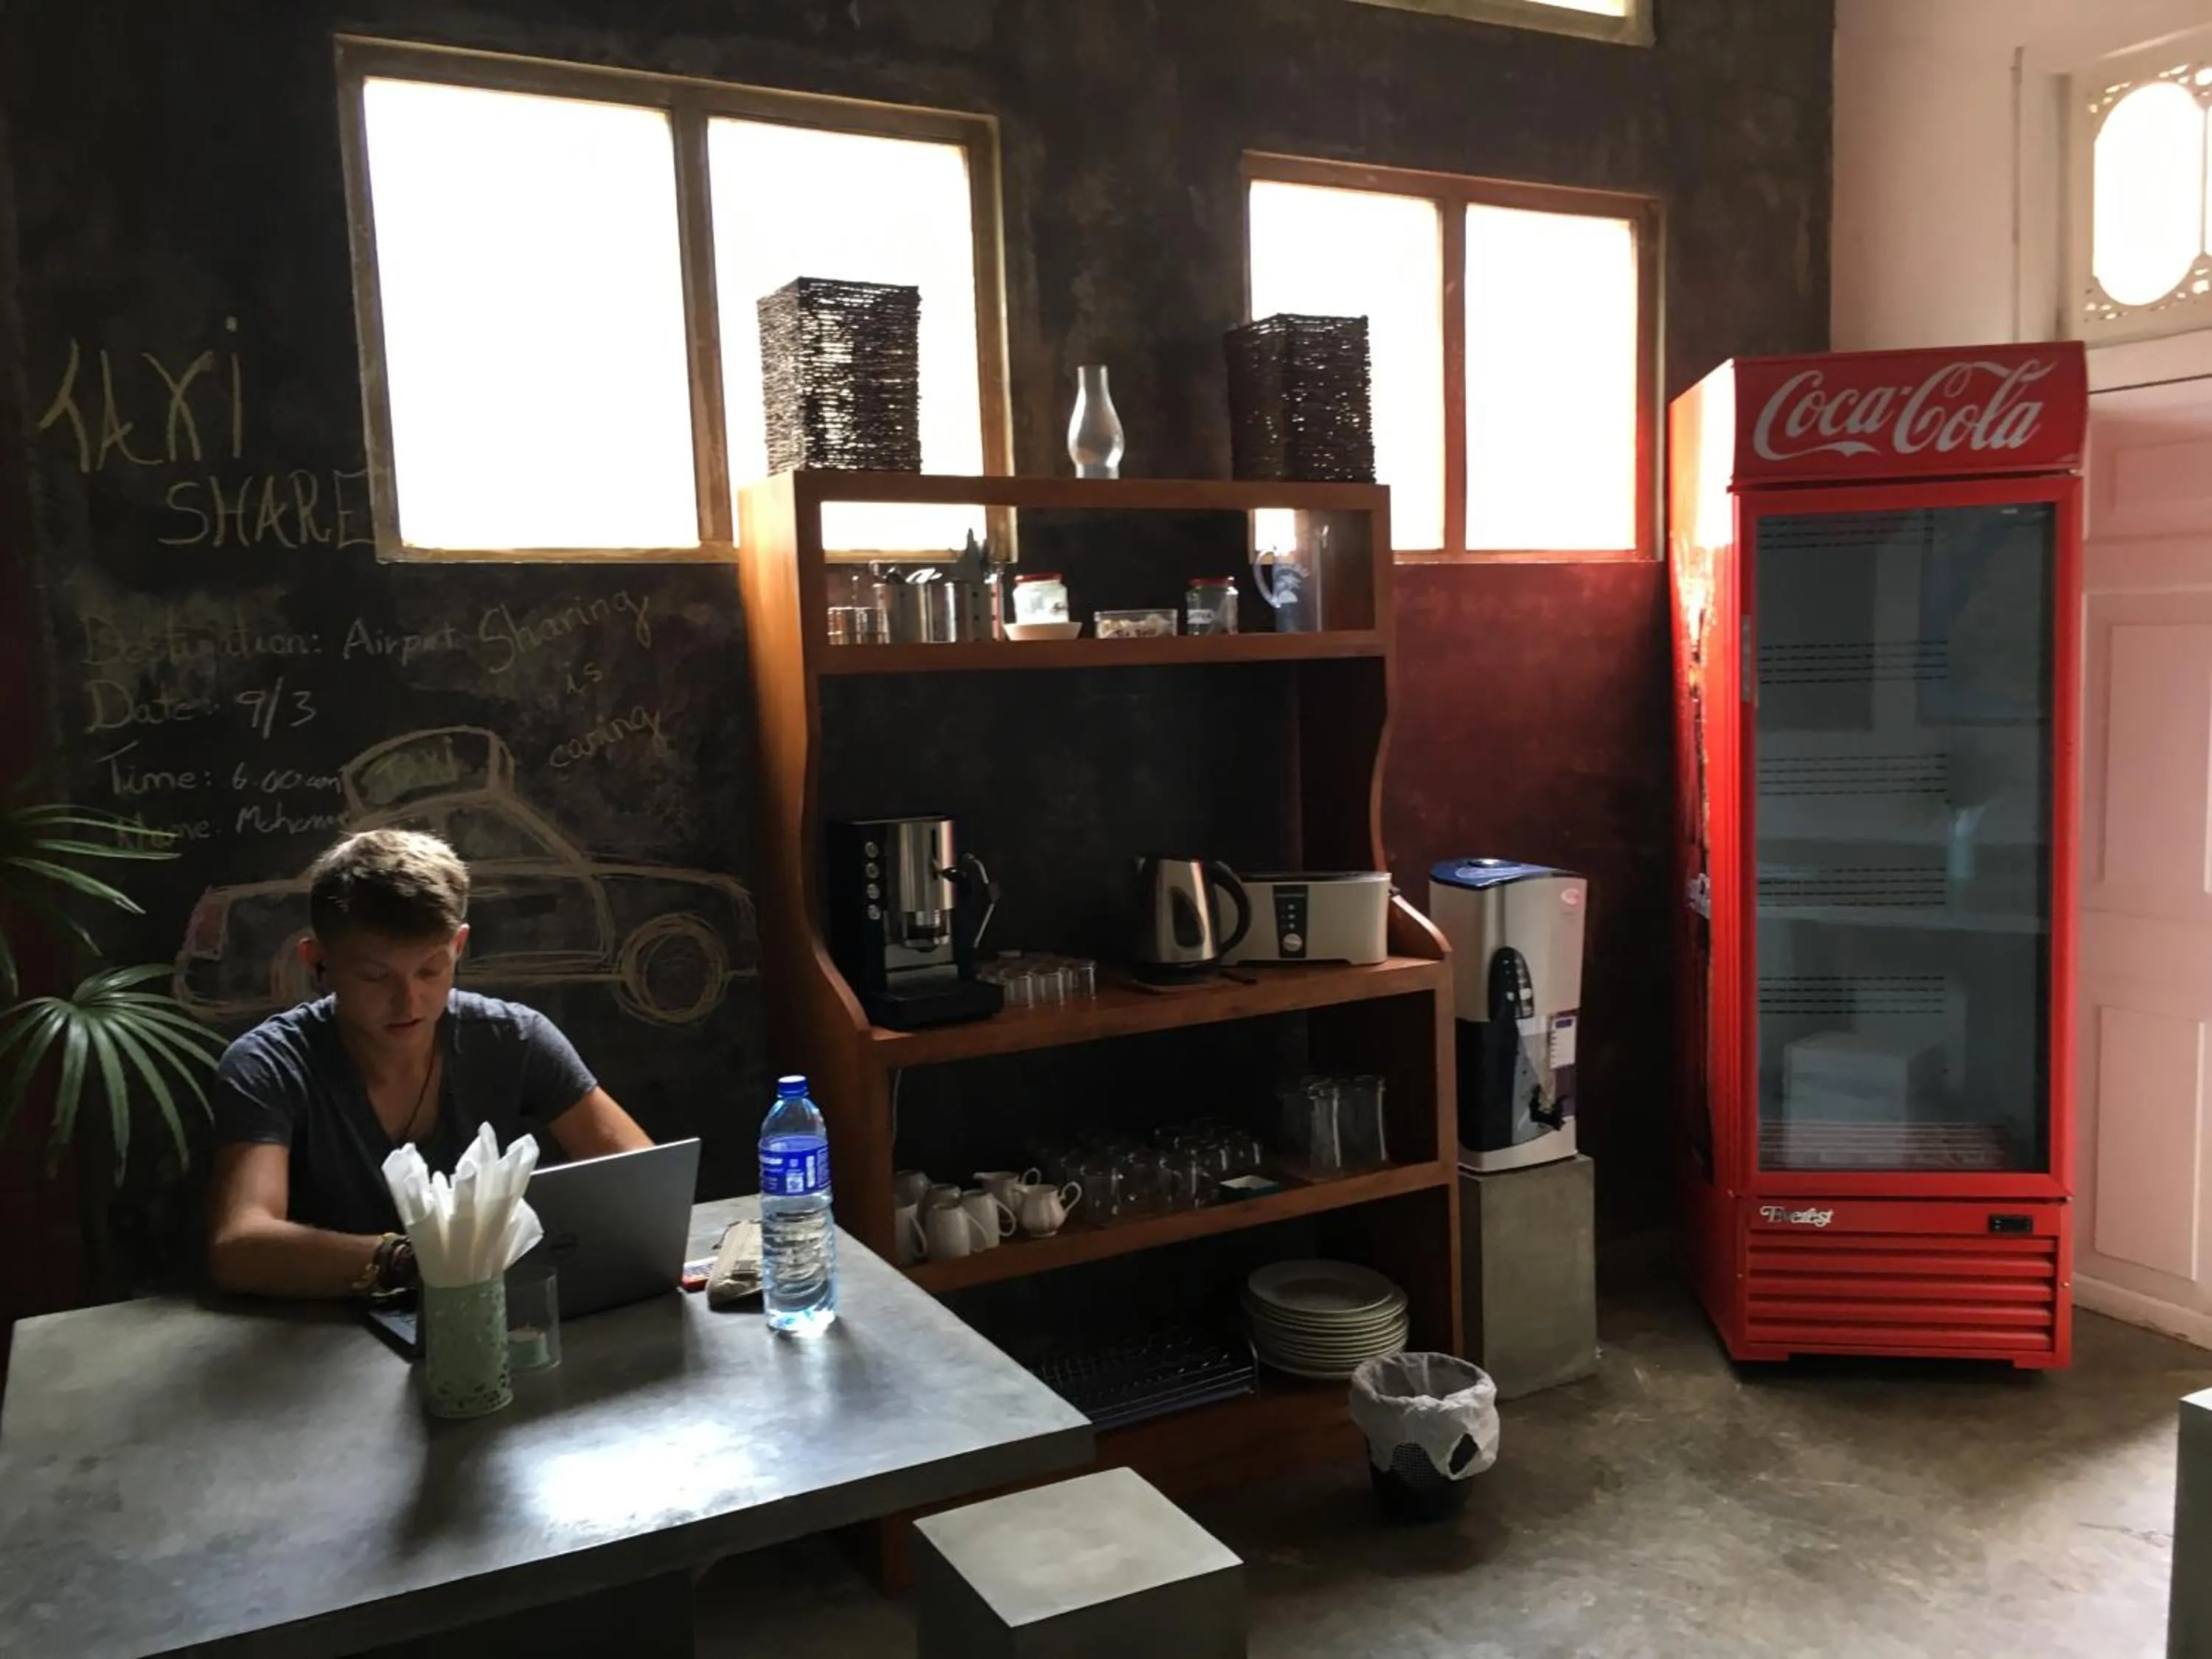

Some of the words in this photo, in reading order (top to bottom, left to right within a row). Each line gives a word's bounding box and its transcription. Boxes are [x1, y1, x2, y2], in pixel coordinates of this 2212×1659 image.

[1753, 358, 2058, 461] Coca-Cola
[157, 469, 377, 550] SHARE
[479, 590, 650, 674] Sharing
[235, 676, 317, 740] 9/3
[96, 741, 212, 794] Time:
